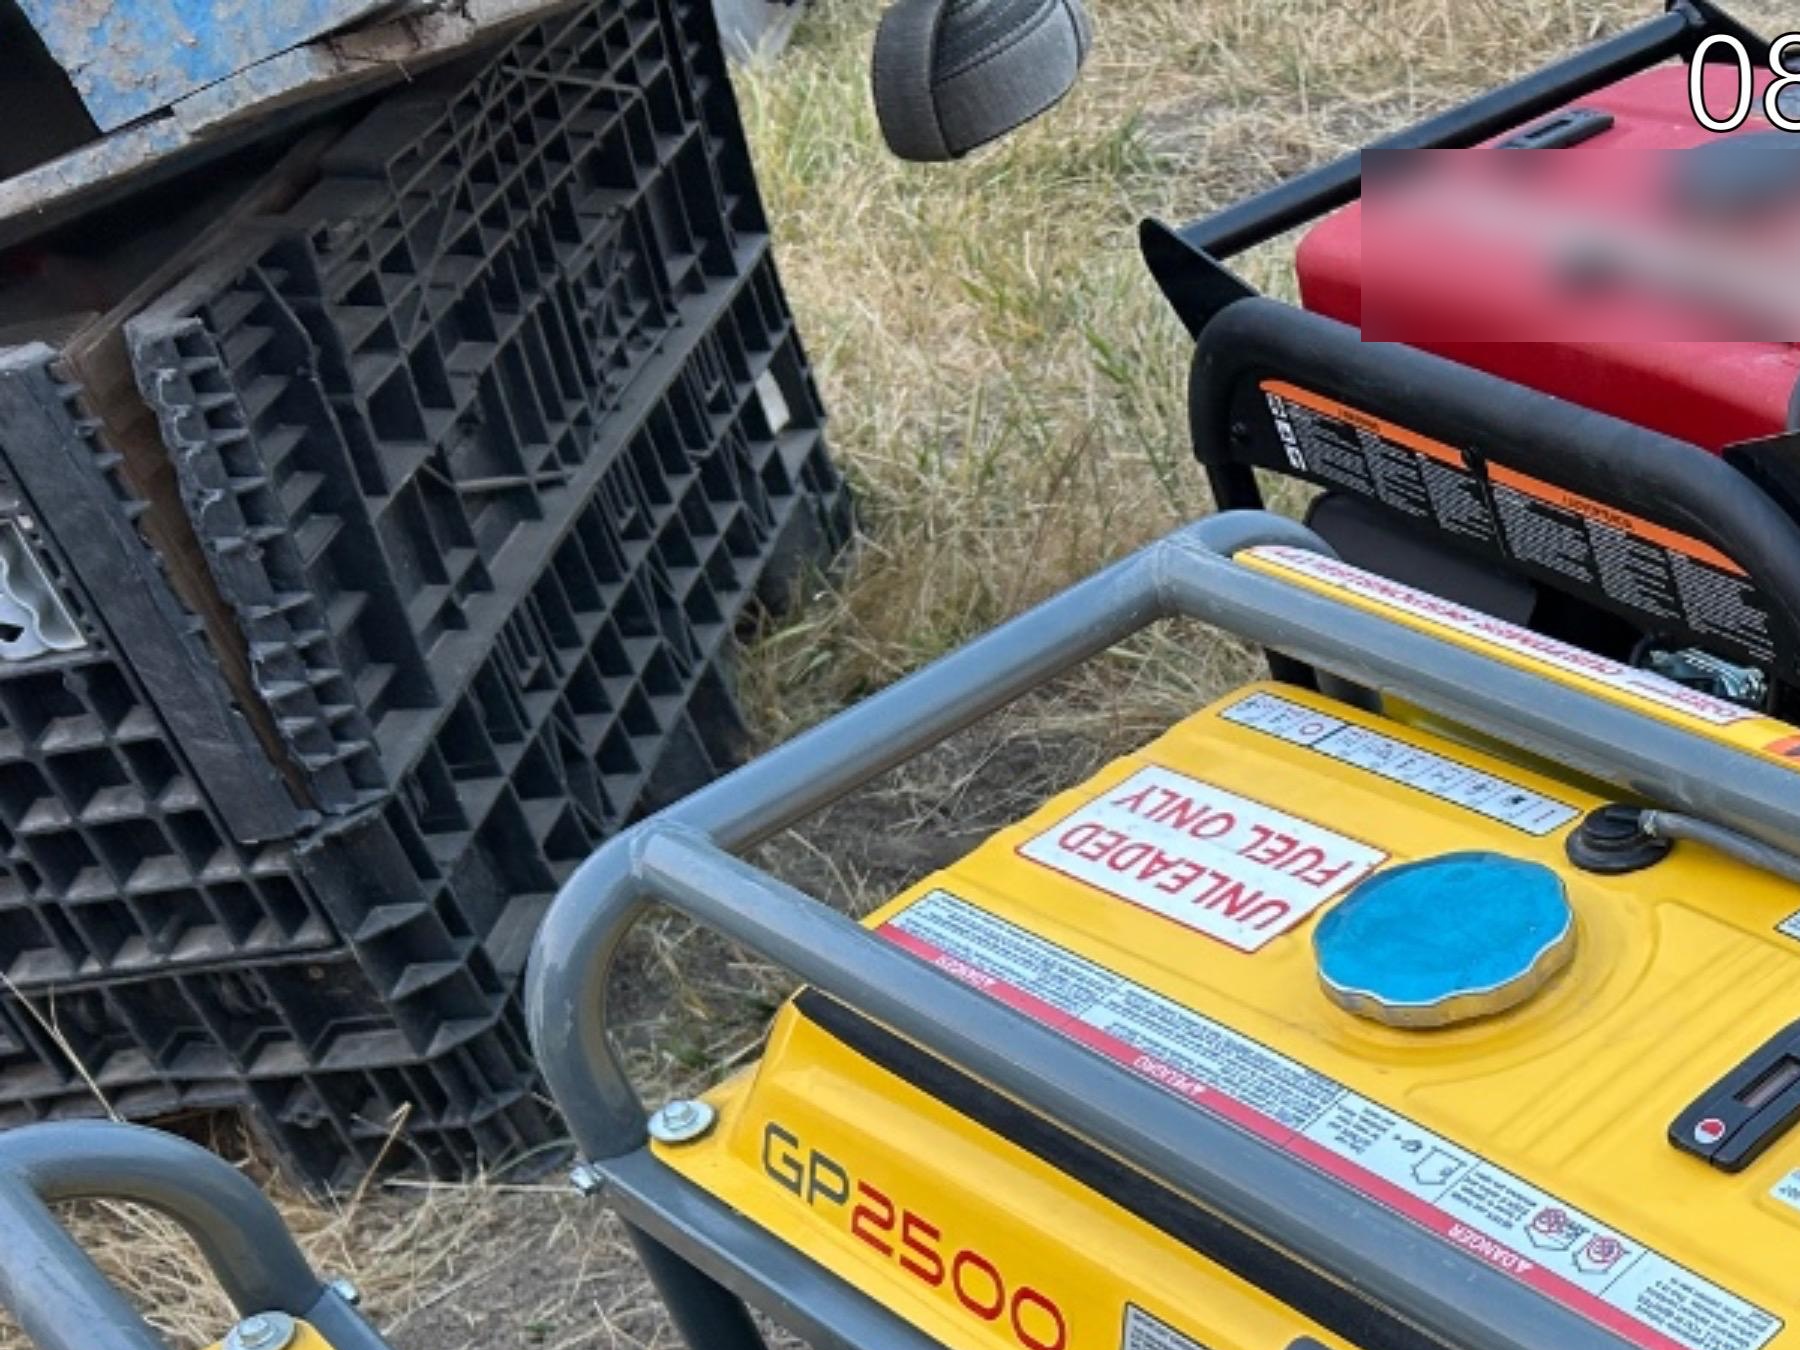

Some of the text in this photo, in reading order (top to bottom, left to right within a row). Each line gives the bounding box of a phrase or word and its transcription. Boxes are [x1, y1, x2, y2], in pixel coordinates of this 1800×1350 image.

[1059, 822, 1291, 930] UNLEADED
[1111, 785, 1353, 887] FUEL ONLY
[1447, 1223, 1519, 1269] DANGER
